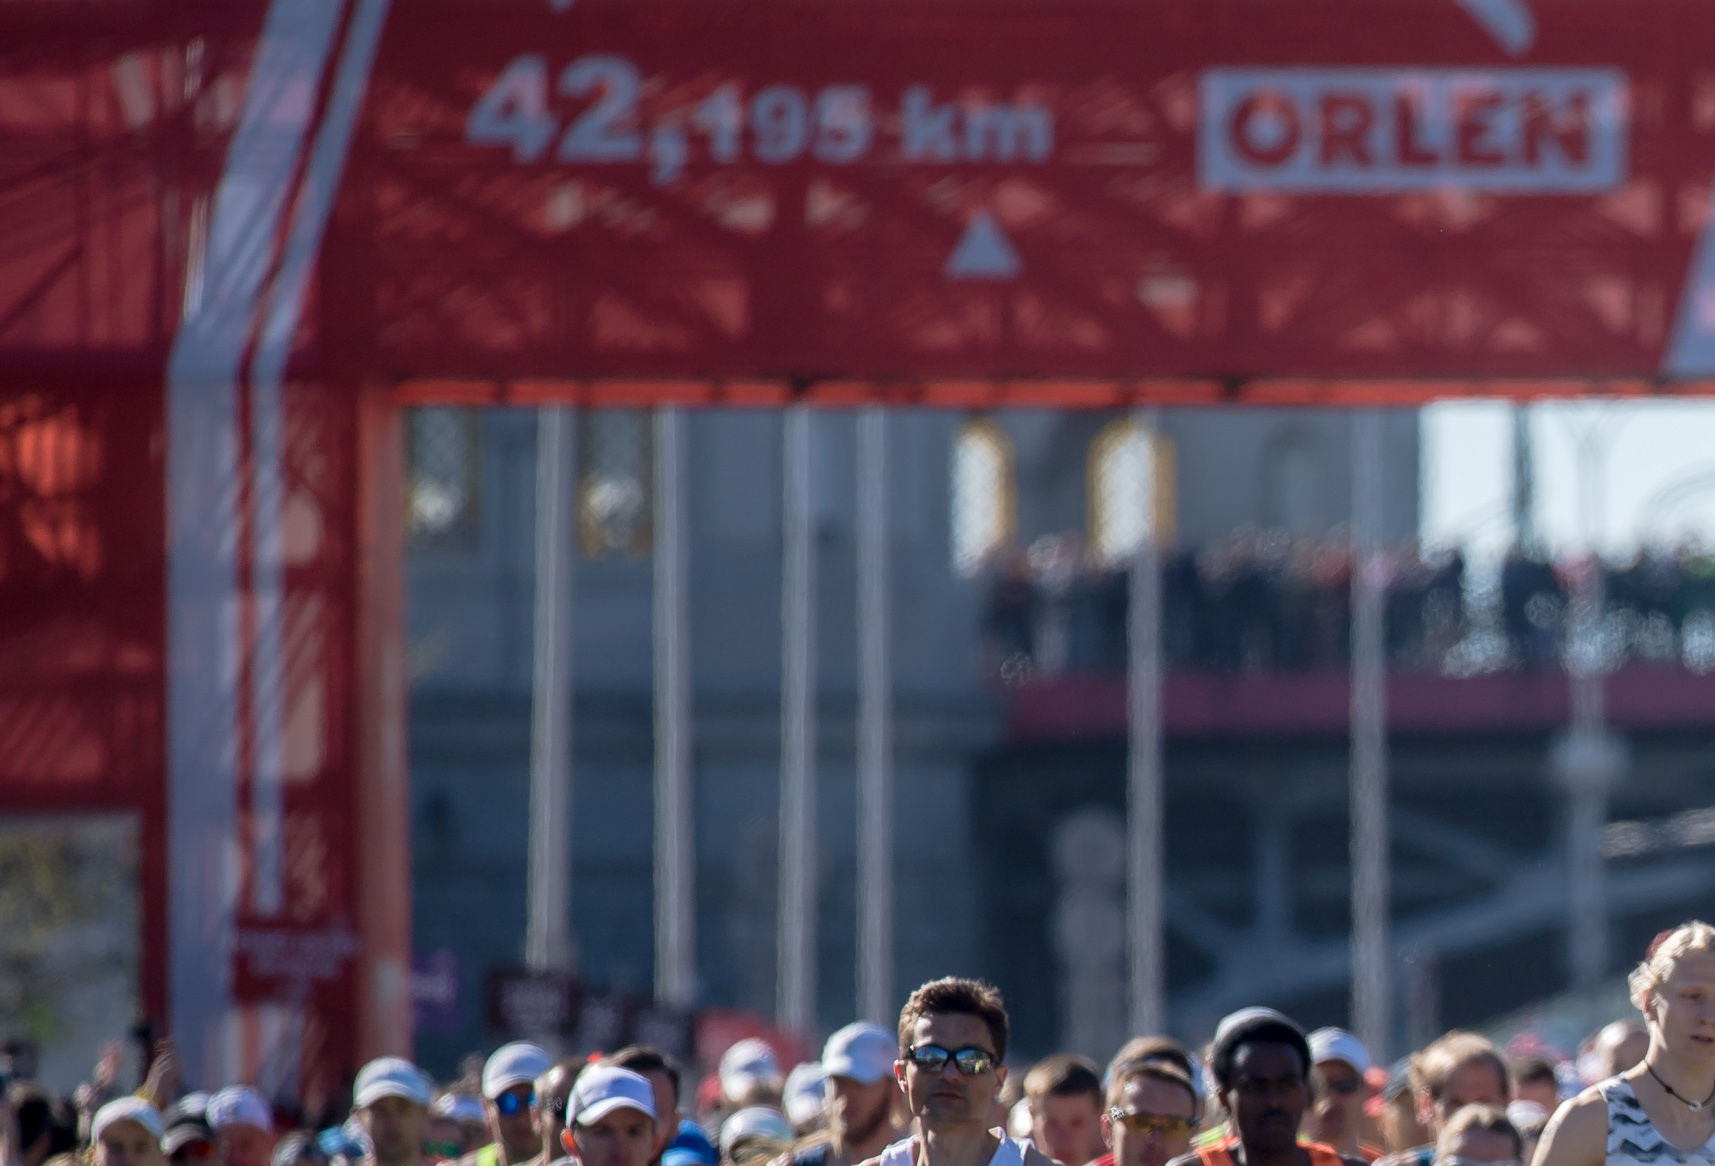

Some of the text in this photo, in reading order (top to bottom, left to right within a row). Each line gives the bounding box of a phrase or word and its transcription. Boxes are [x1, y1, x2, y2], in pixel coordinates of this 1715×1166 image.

[468, 55, 1055, 184] 42,195 km
[1226, 92, 1594, 170] ORLEN
